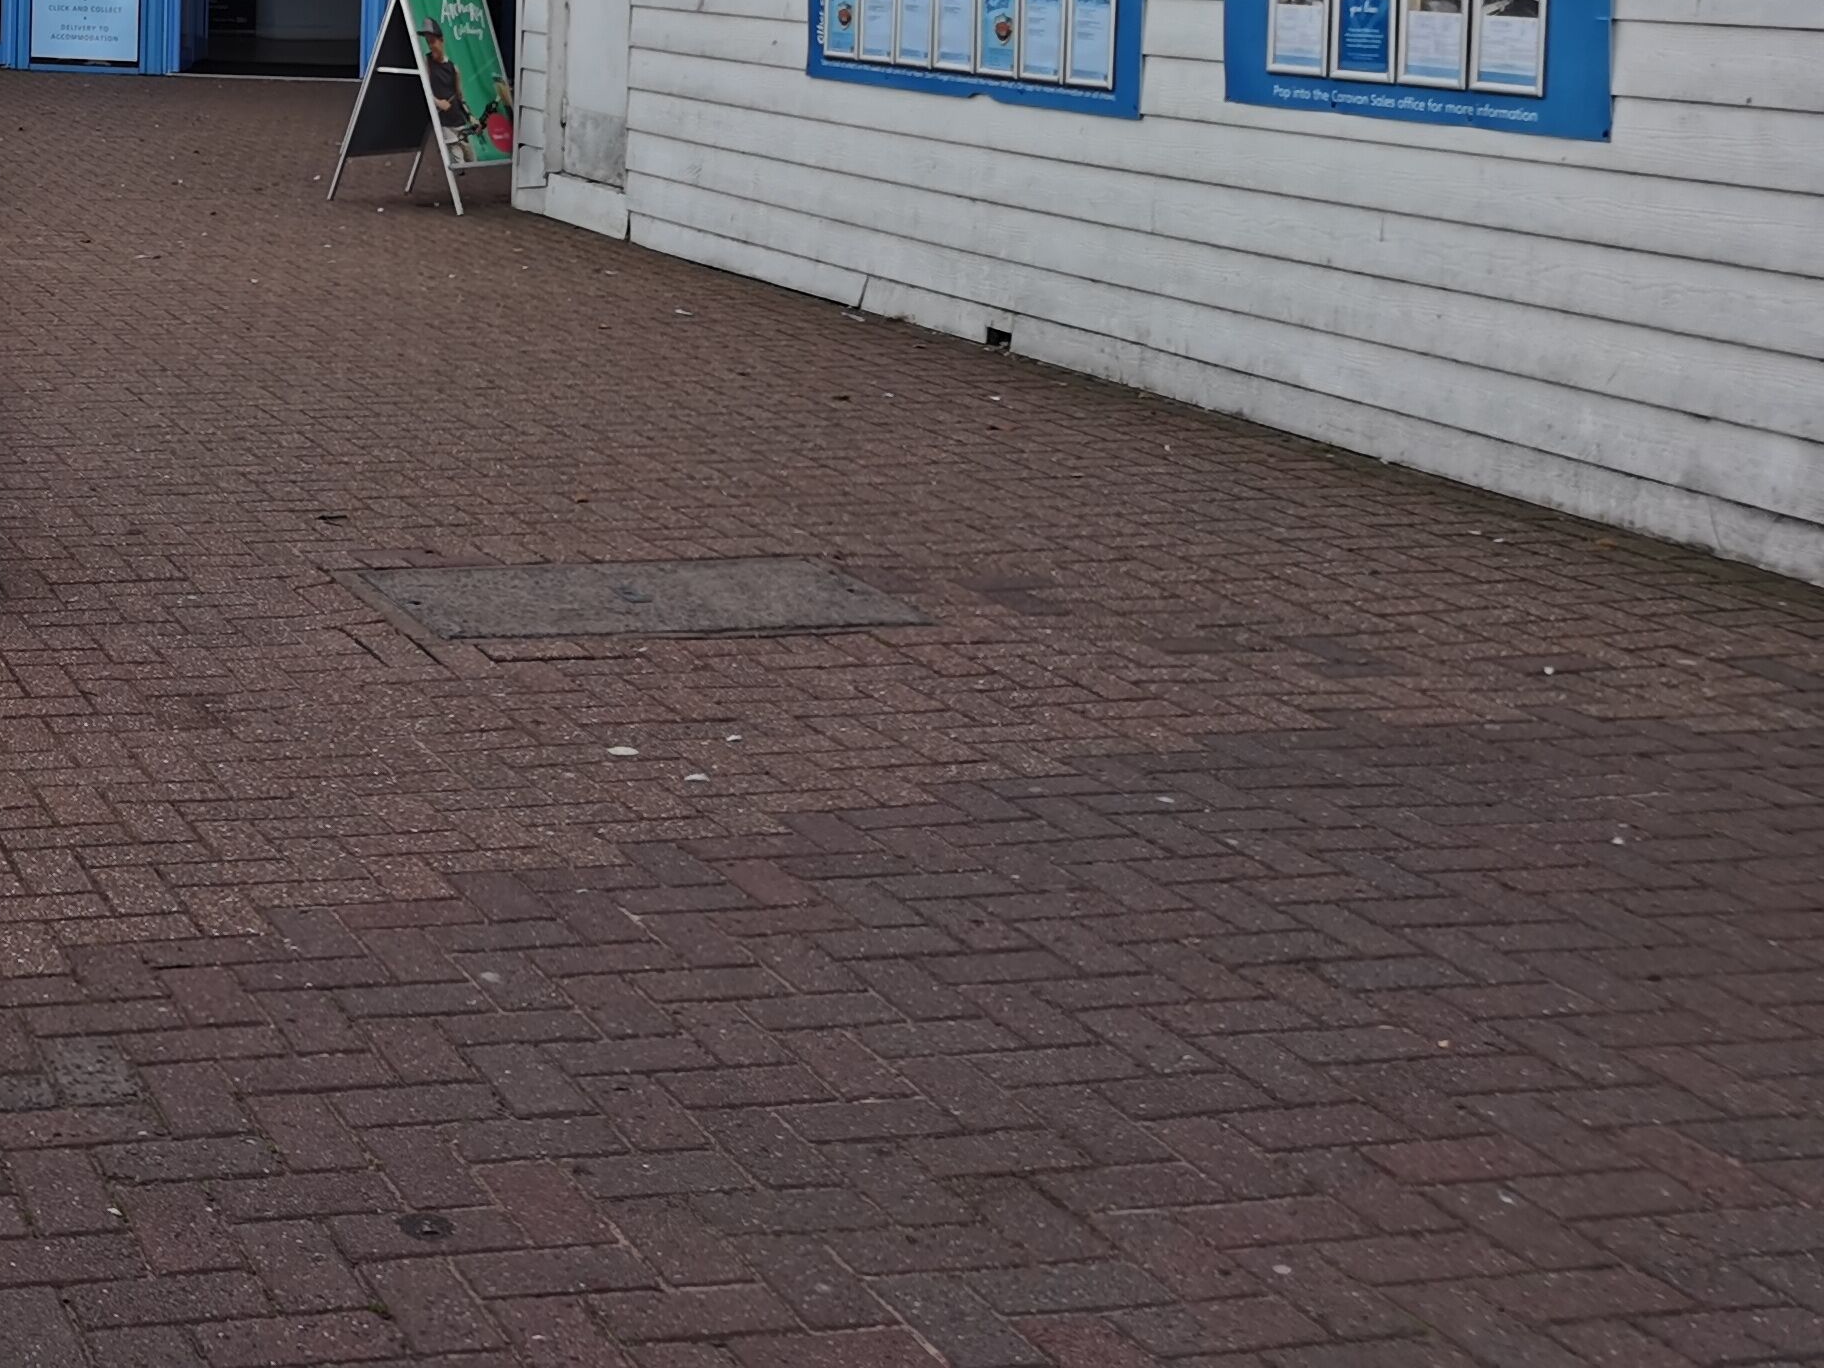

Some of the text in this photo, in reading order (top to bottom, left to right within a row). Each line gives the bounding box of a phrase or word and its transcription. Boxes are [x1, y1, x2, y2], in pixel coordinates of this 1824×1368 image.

[1273, 84, 1538, 123] Pop into the Caravan Sales office for more information
